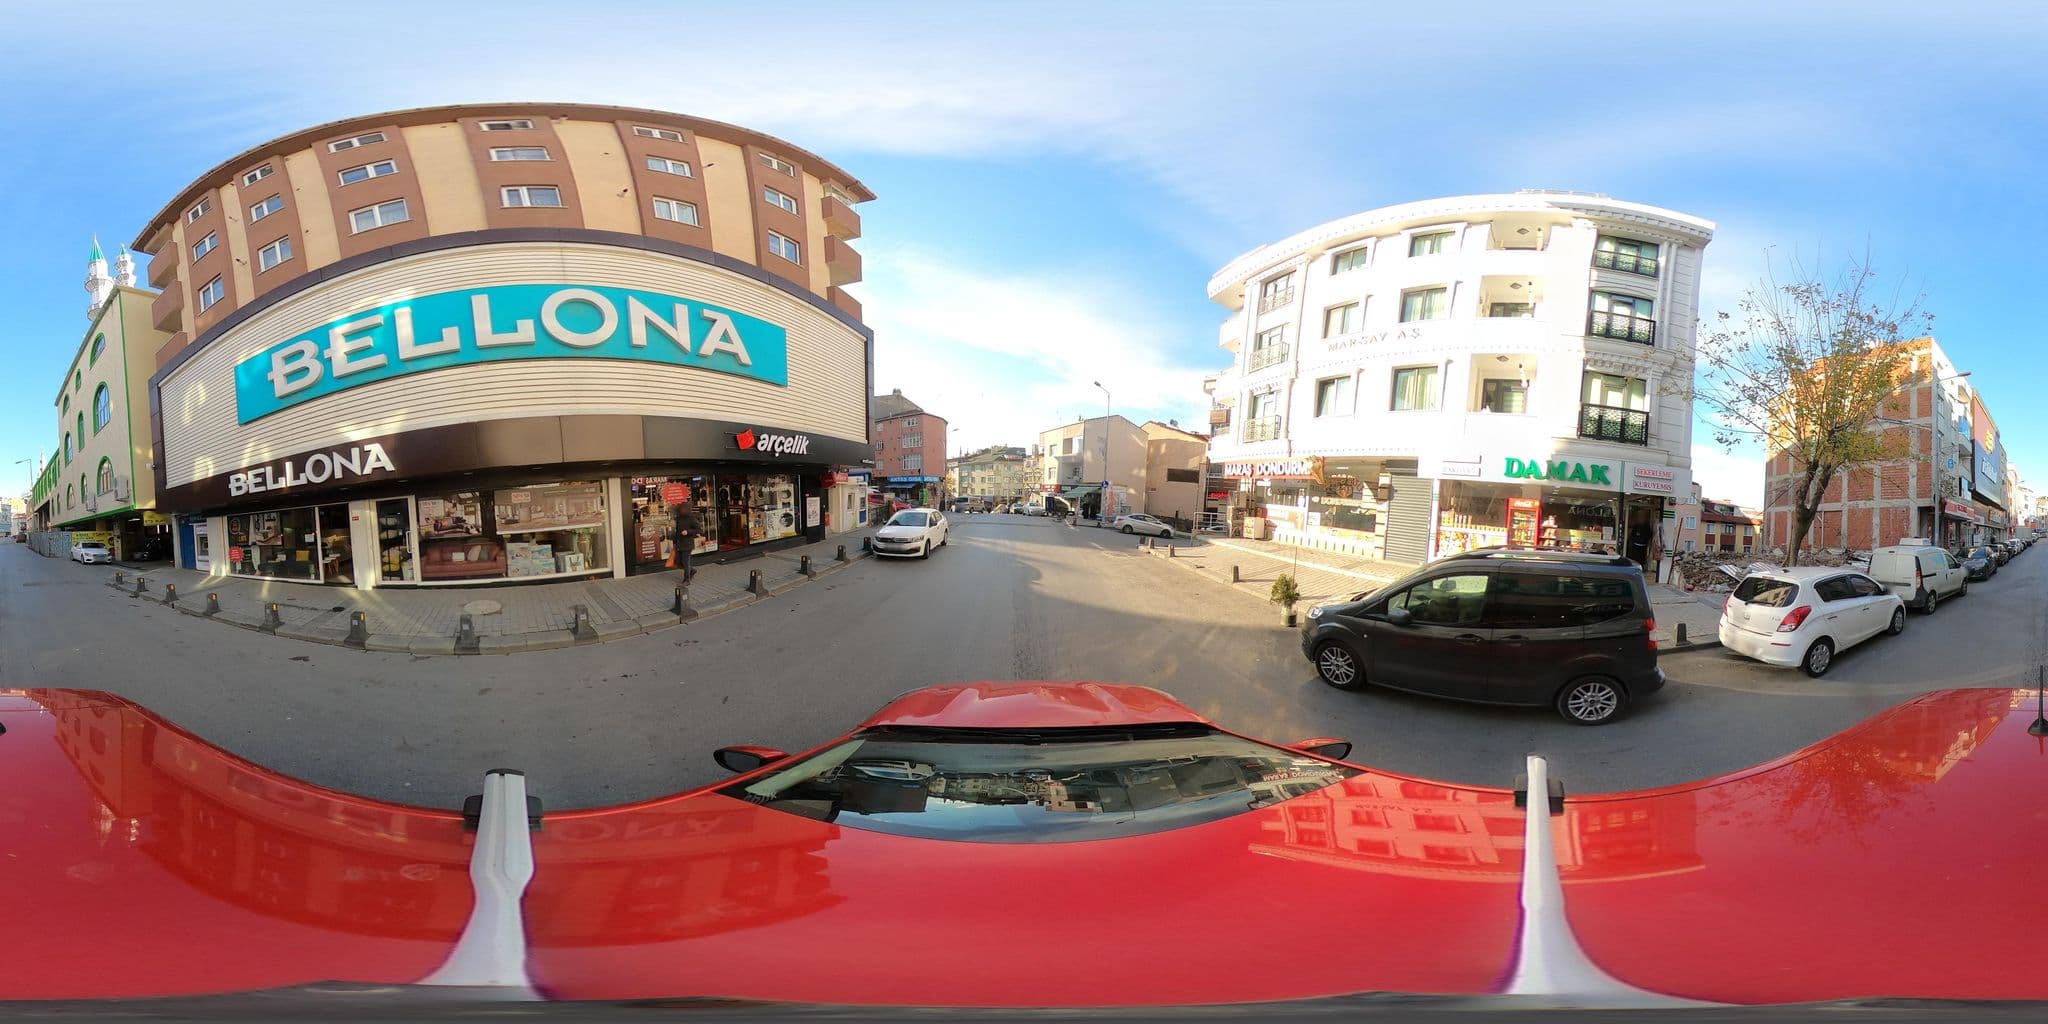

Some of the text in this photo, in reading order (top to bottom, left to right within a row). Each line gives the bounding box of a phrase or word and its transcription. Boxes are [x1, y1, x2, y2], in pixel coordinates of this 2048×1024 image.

[266, 287, 753, 400] BELLONA
[757, 433, 810, 457] arçelik
[228, 443, 397, 497] BELLONA
[1503, 457, 1612, 485] DAMAK
